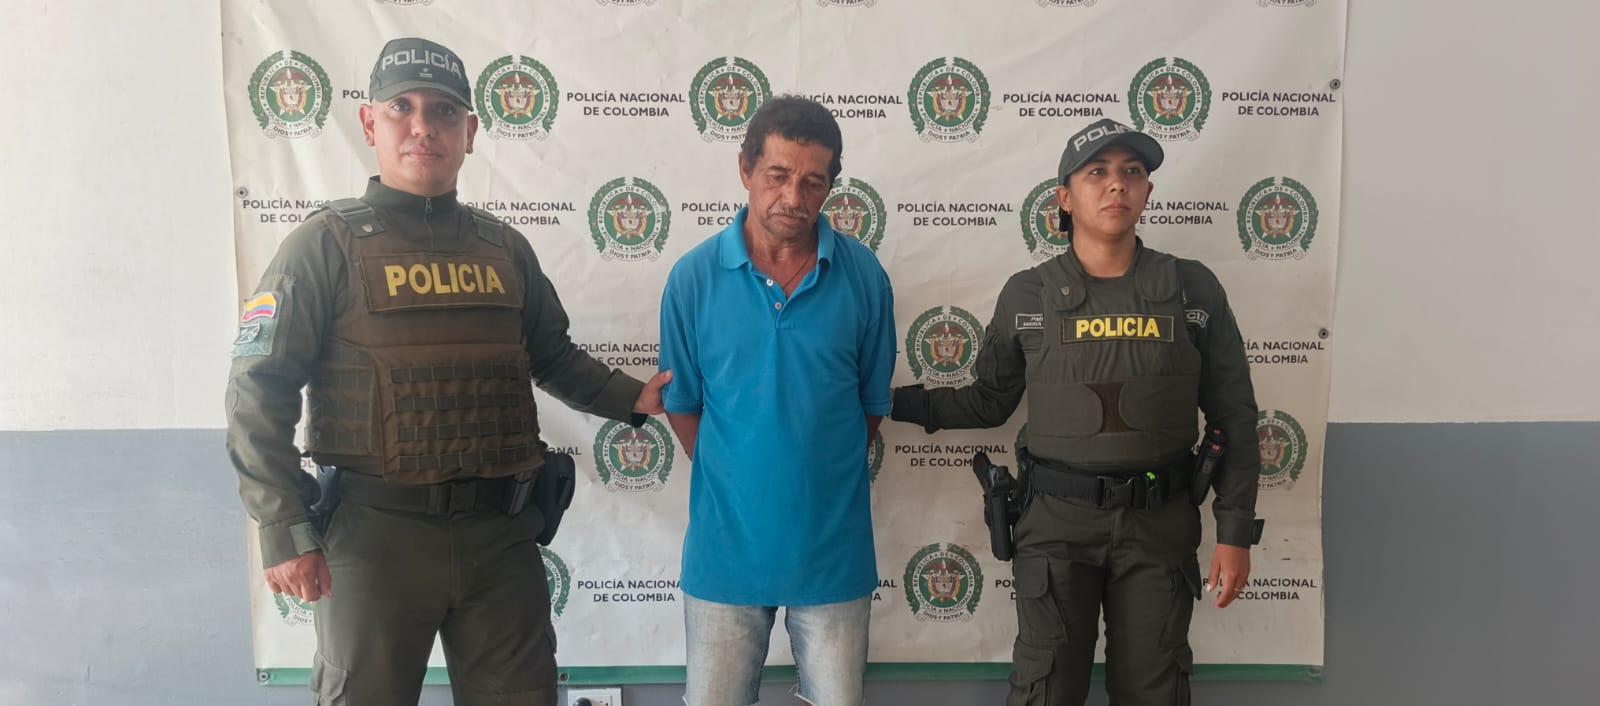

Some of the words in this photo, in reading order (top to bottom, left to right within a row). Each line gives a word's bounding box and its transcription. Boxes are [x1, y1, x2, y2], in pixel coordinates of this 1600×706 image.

[567, 92, 616, 102] POLICÍA
[620, 93, 686, 103] NACIONAL
[797, 92, 834, 104] LICÍA
[838, 95, 902, 105] NACIONAL
[1003, 92, 1052, 103] POLICÍA
[1056, 93, 1120, 103] NACIONAL
[1222, 91, 1269, 101] POLICÍA
[1273, 92, 1336, 102] NACIONAL
[583, 107, 599, 116] DE
[603, 107, 669, 117] COLOMBIA
[831, 109, 886, 118] OLOMBIA
[1019, 108, 1035, 117] DE
[1038, 108, 1103, 117] COLOMBIA
[1238, 106, 1253, 115] DE
[1257, 106, 1319, 116] COLOMBIA
[732, 120, 751, 131] NACIO
[1074, 124, 1131, 152] POLI
[1148, 130, 1163, 138] DIOS
[1169, 130, 1191, 139] PATRIA
[243, 198, 292, 209] POLICÍA
[464, 200, 506, 211] OLICÍA
[510, 202, 576, 211] NACIONAL
[682, 202, 730, 212] POLICÍA
[898, 202, 945, 212] POLICÍA
[950, 203, 1013, 213] NACIONAL
[1167, 202, 1229, 211] NACIONAL
[260, 214, 276, 222] DE
[698, 217, 714, 226] DE
[914, 217, 928, 226] DE
[932, 217, 997, 226] COLOMBIA
[1150, 216, 1213, 224] COLOMBIA
[384, 263, 505, 296] POLICIA
[1076, 318, 1160, 338] POLICIA
[624, 343, 659, 352] NACIO
[1263, 342, 1324, 351] NACIONAL
[607, 357, 658, 366] COLOMB
[1247, 355, 1308, 364] COLOMBIA
[895, 445, 943, 454] POLICÍA
[946, 445, 1007, 454] NACIONAL
[911, 458, 926, 467] DE
[929, 458, 972, 467] COLOM
[544, 560, 560, 588] OLOMBIA
[578, 579, 624, 589] POLICÍA
[628, 580, 680, 589] NACION
[1254, 579, 1317, 588] NACIONAL
[594, 594, 608, 602] DE
[612, 593, 675, 602] COLOMBIA
[1237, 592, 1299, 600] COLOMBIA
